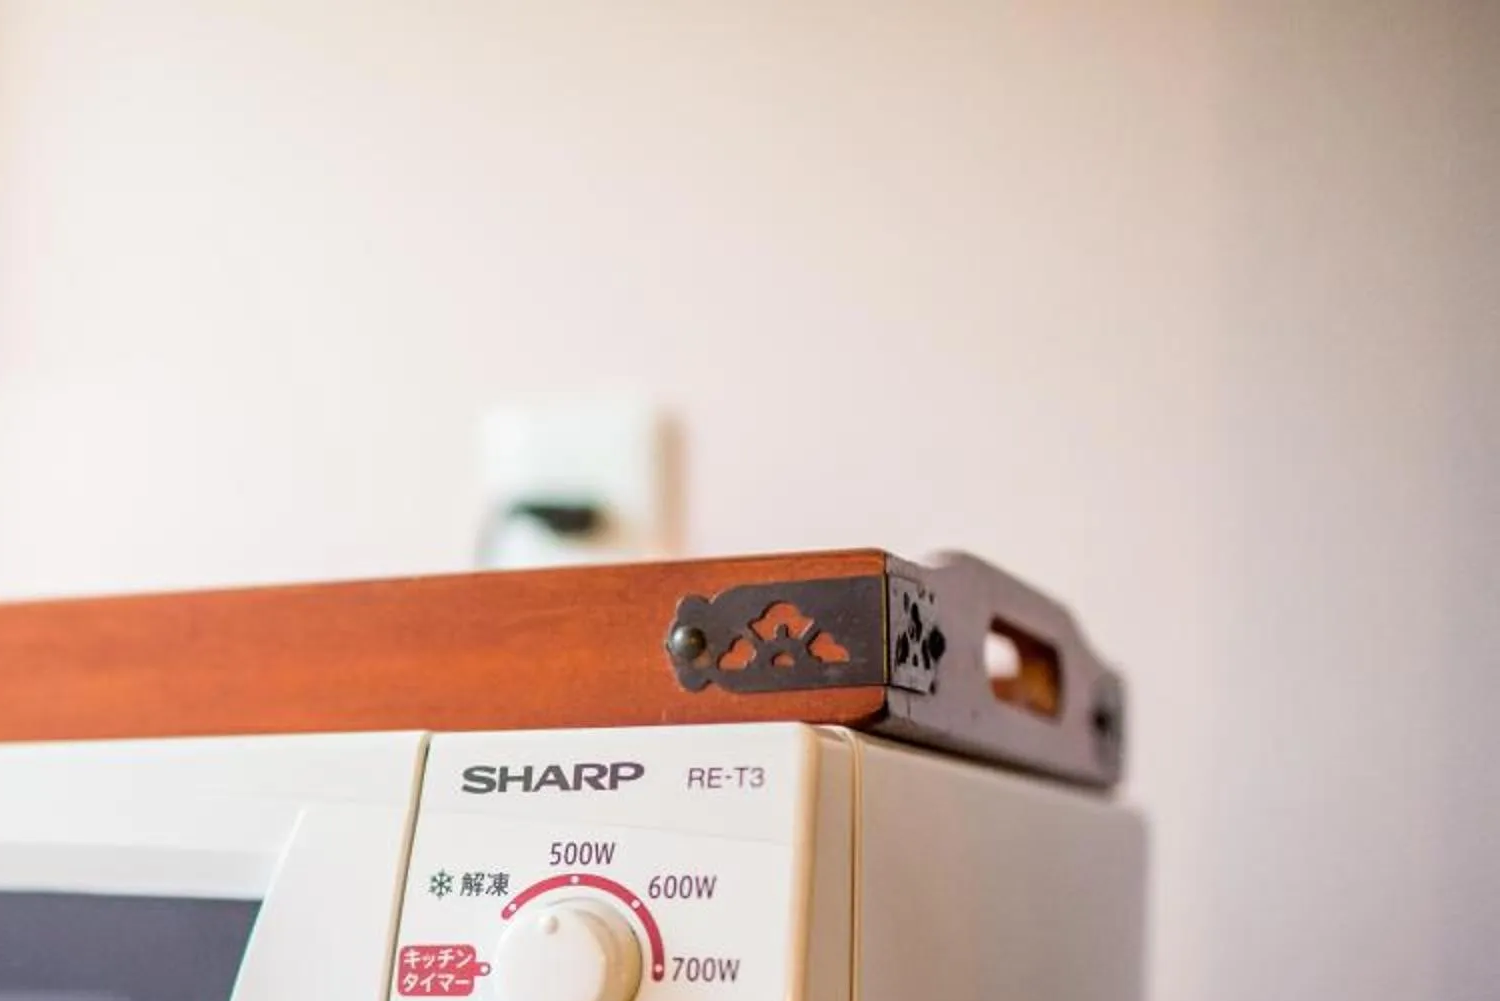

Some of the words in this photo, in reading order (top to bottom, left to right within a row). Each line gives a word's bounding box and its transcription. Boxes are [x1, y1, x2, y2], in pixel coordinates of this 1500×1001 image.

[461, 762, 645, 794] SHARP
[687, 767, 765, 790] RE-T3
[549, 842, 616, 866] 500W
[460, 872, 510, 898] 解凍
[648, 875, 717, 900] 600W
[403, 949, 475, 969] キッチン
[671, 957, 740, 983] 700W
[402, 973, 472, 993] タイマー
